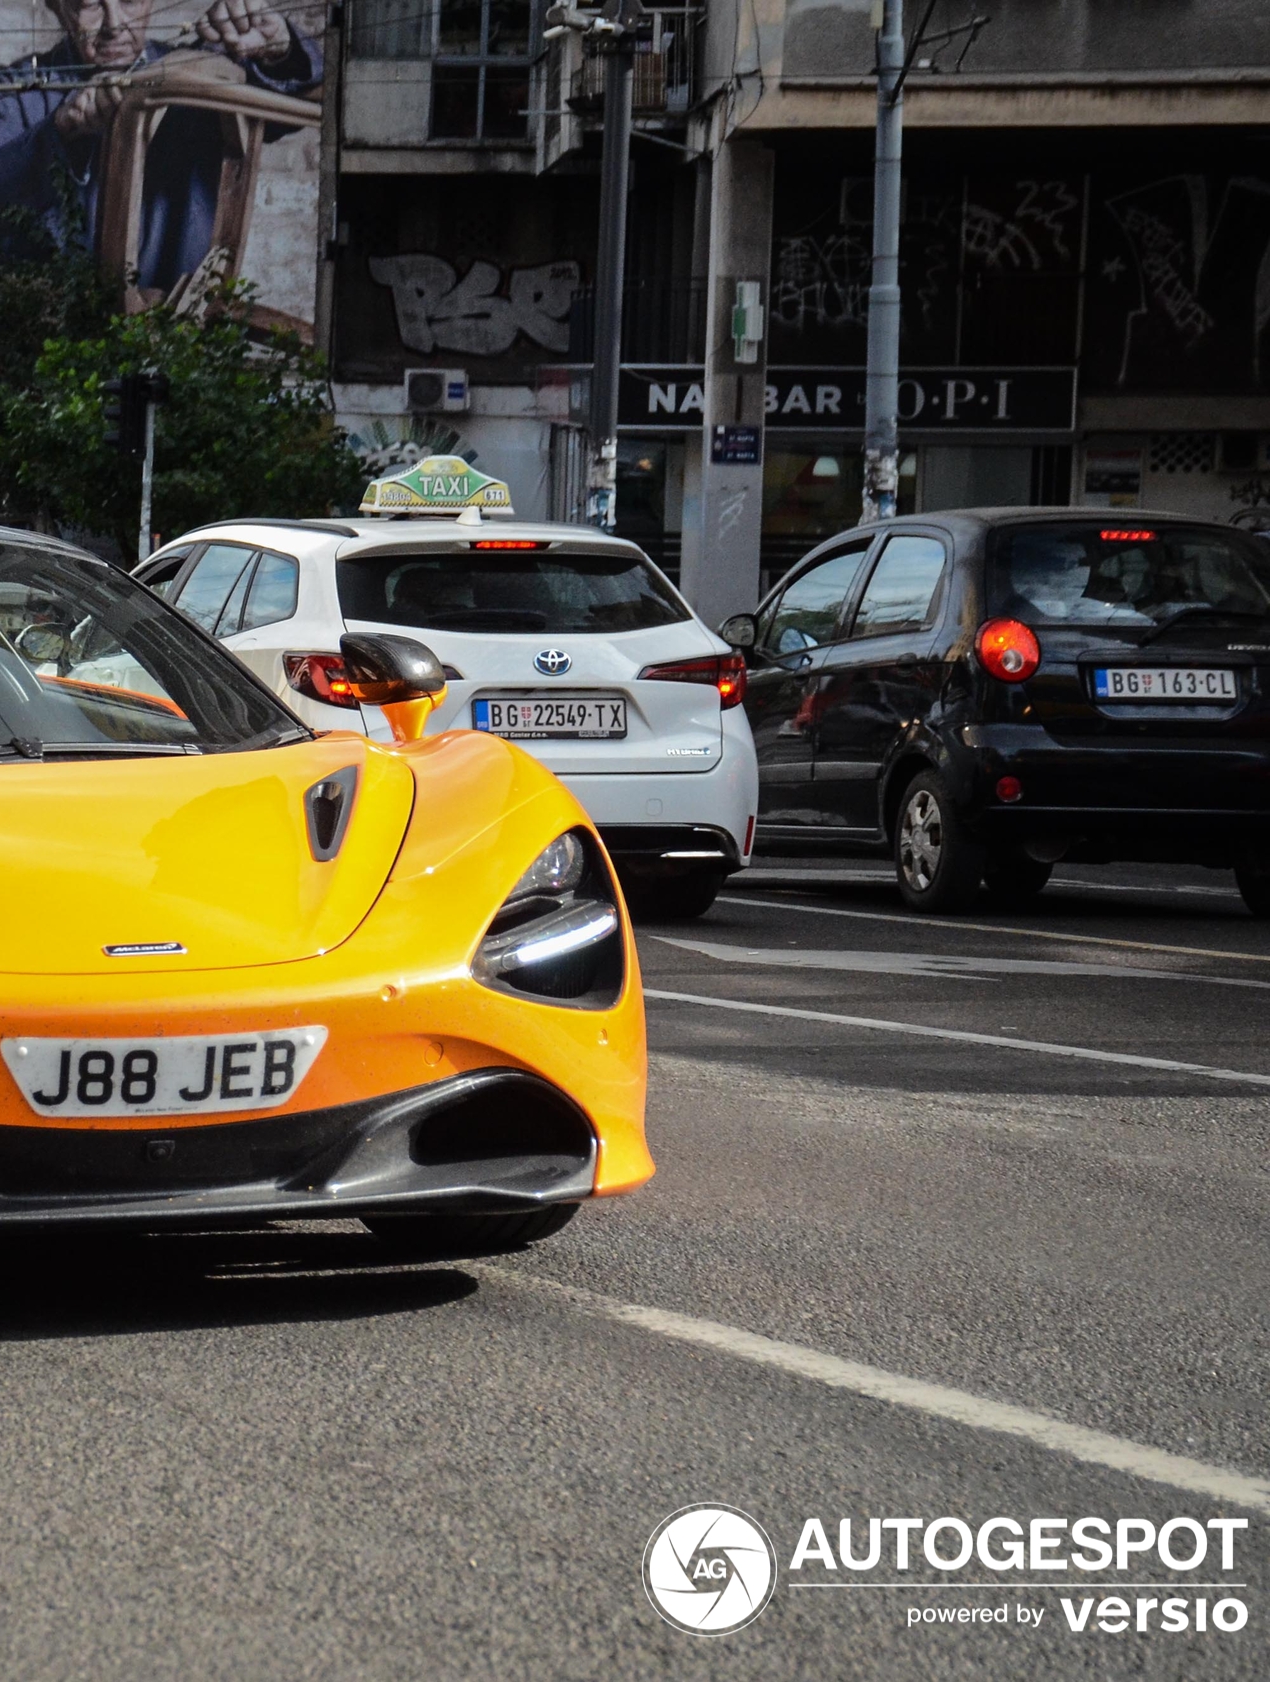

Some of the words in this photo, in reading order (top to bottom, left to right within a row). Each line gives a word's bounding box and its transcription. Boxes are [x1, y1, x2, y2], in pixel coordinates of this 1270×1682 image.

[764, 384, 843, 415] BAR
[418, 475, 470, 497] TAXI
[485, 489, 504, 500] 671
[1112, 672, 1139, 694] BG
[490, 703, 519, 728] BG
[111, 944, 174, 953] McLaren
[32, 1049, 158, 1106] J88
[179, 1038, 297, 1102] JEB
